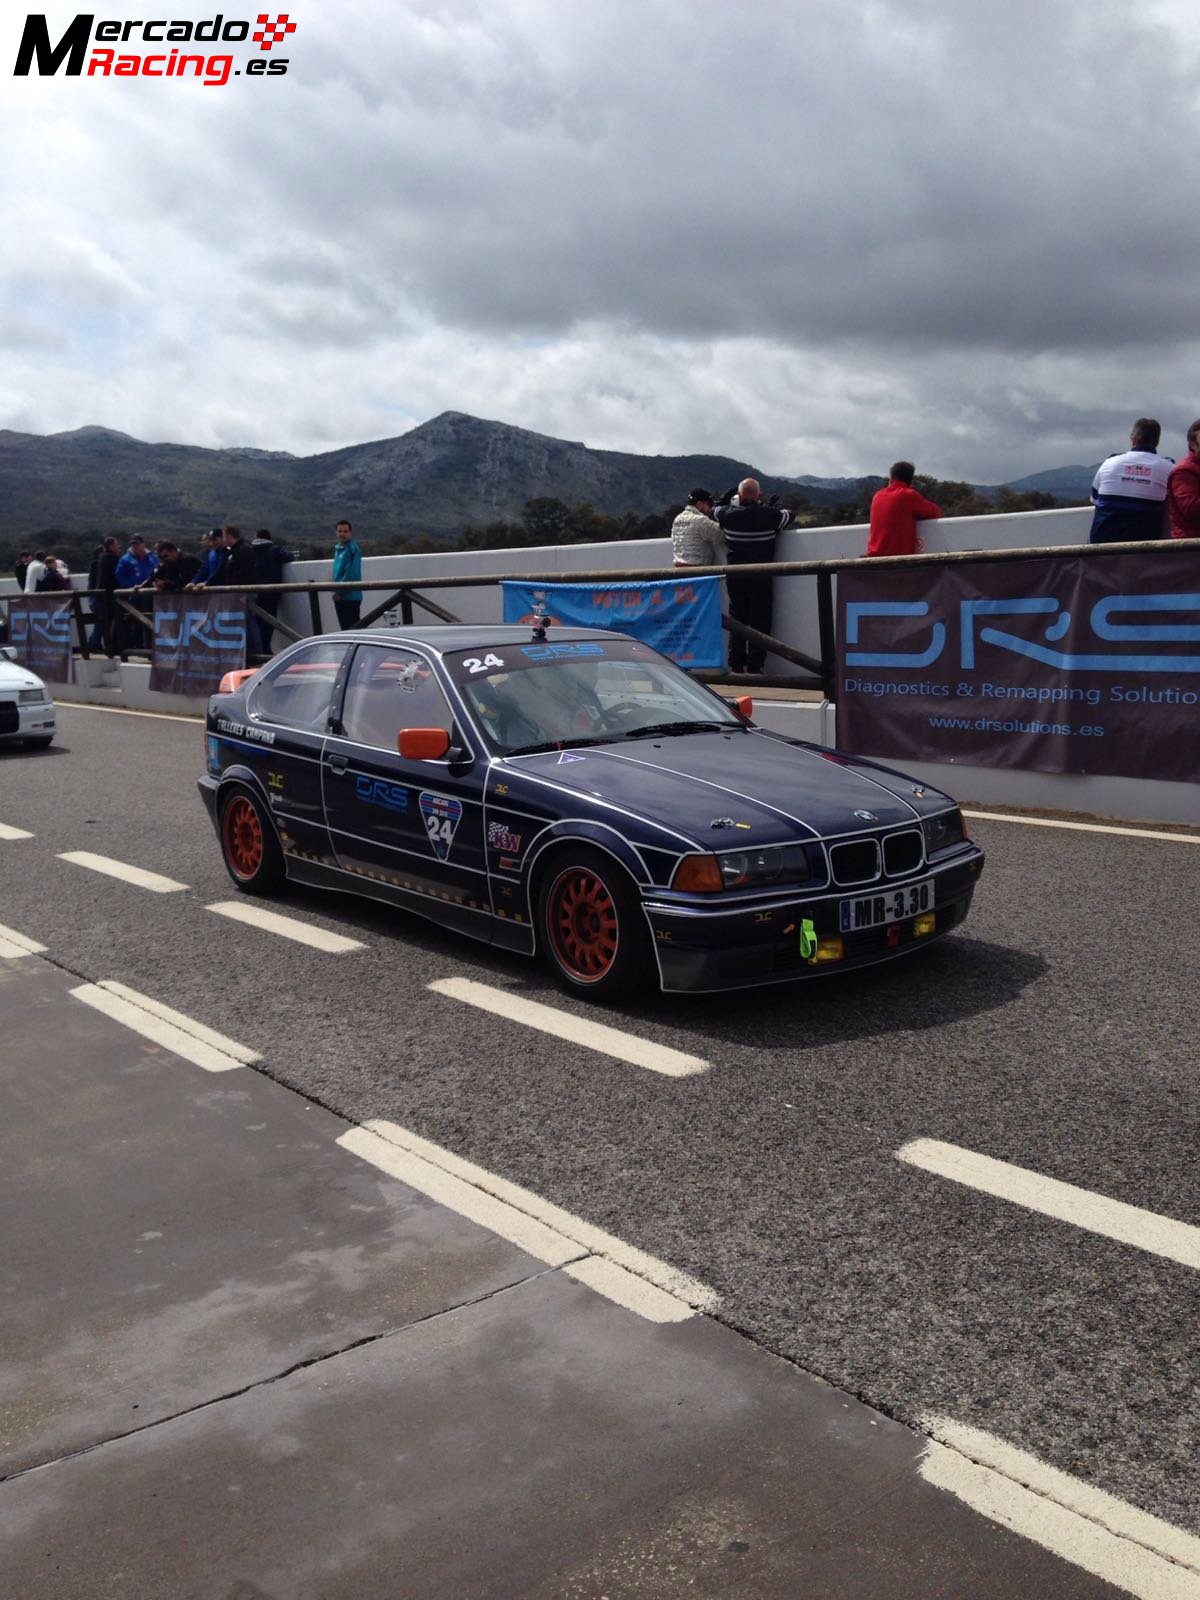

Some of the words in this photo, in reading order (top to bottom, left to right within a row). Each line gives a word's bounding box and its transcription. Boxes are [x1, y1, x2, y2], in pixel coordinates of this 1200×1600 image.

[846, 593, 1200, 673] DRS
[462, 653, 505, 674] 24
[844, 678, 950, 698] Diagnostics
[957, 682, 974, 697] &
[981, 683, 1101, 705] Remapping
[929, 716, 1105, 737] www.drsolutions.es
[356, 776, 408, 808] DRS
[427, 816, 454, 845] 24
[854, 884, 929, 928] MR-3.30
